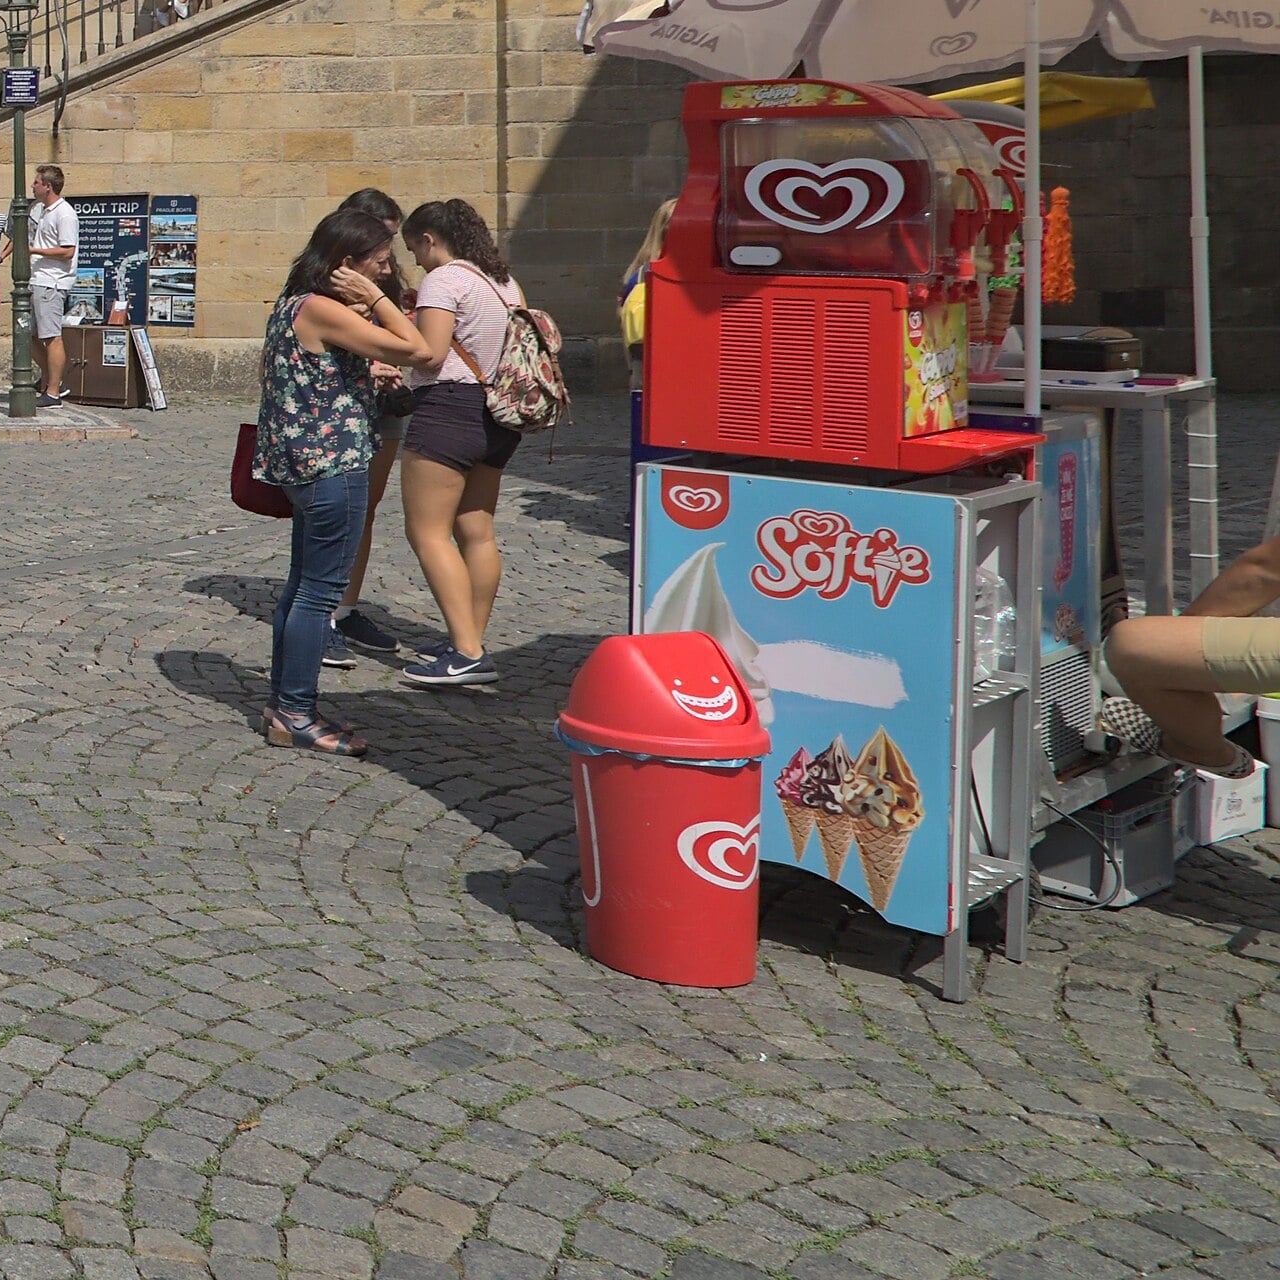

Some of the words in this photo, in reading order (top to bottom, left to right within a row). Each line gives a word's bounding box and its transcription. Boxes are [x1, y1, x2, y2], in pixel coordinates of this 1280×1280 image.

[74, 202, 108, 214] BOAT
[110, 202, 140, 213] TRIP
[752, 516, 931, 607] Softie
